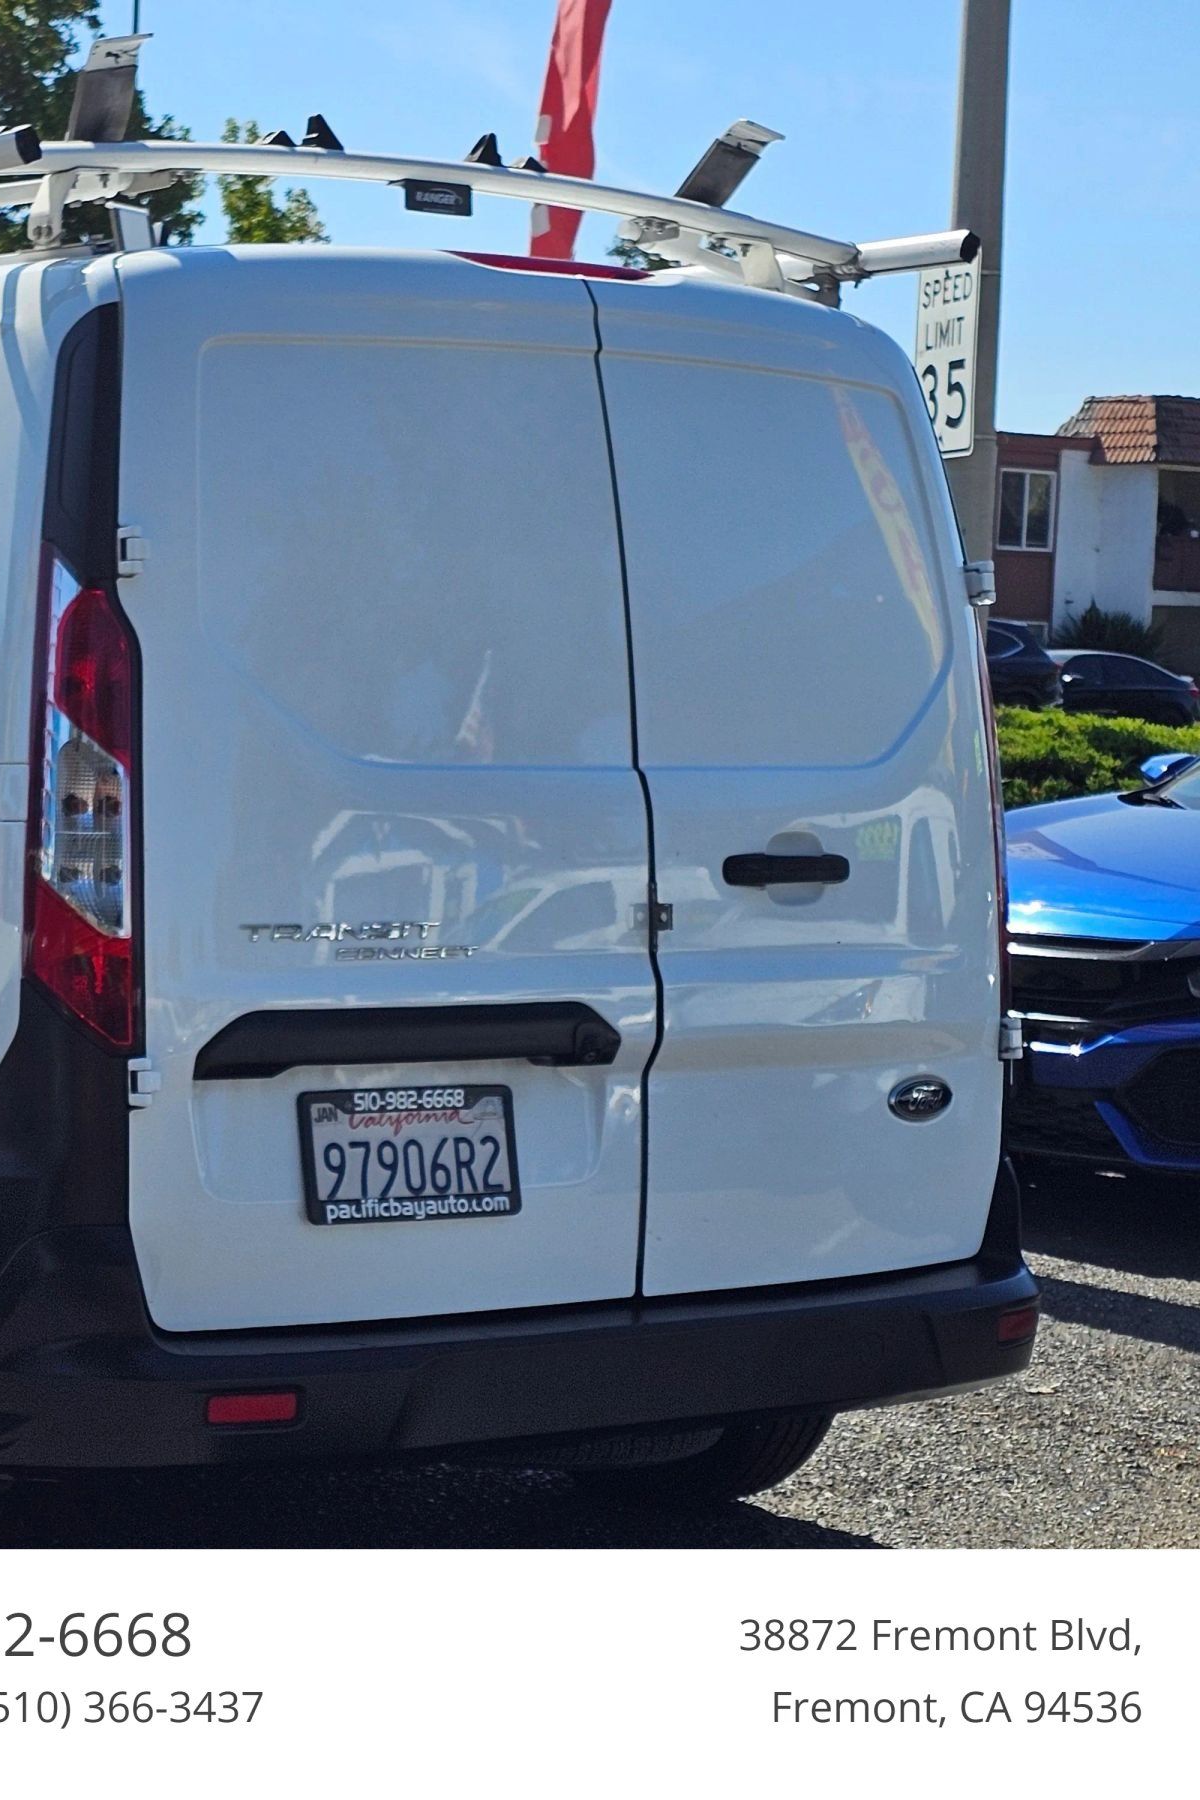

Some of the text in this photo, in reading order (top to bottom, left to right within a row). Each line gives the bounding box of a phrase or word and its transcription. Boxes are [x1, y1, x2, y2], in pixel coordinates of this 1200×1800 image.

[416, 191, 456, 205] RANGER
[922, 271, 974, 309] SPEED
[925, 316, 965, 351] LIMIT
[921, 358, 967, 428] 35
[239, 921, 441, 942] TRANSIT
[354, 1088, 465, 1112] 510-982-6668
[314, 1106, 339, 1123] JAN
[348, 1109, 475, 1137] California
[323, 1134, 505, 1201] 97906R2
[326, 1195, 510, 1224] pacificbayauto.com
